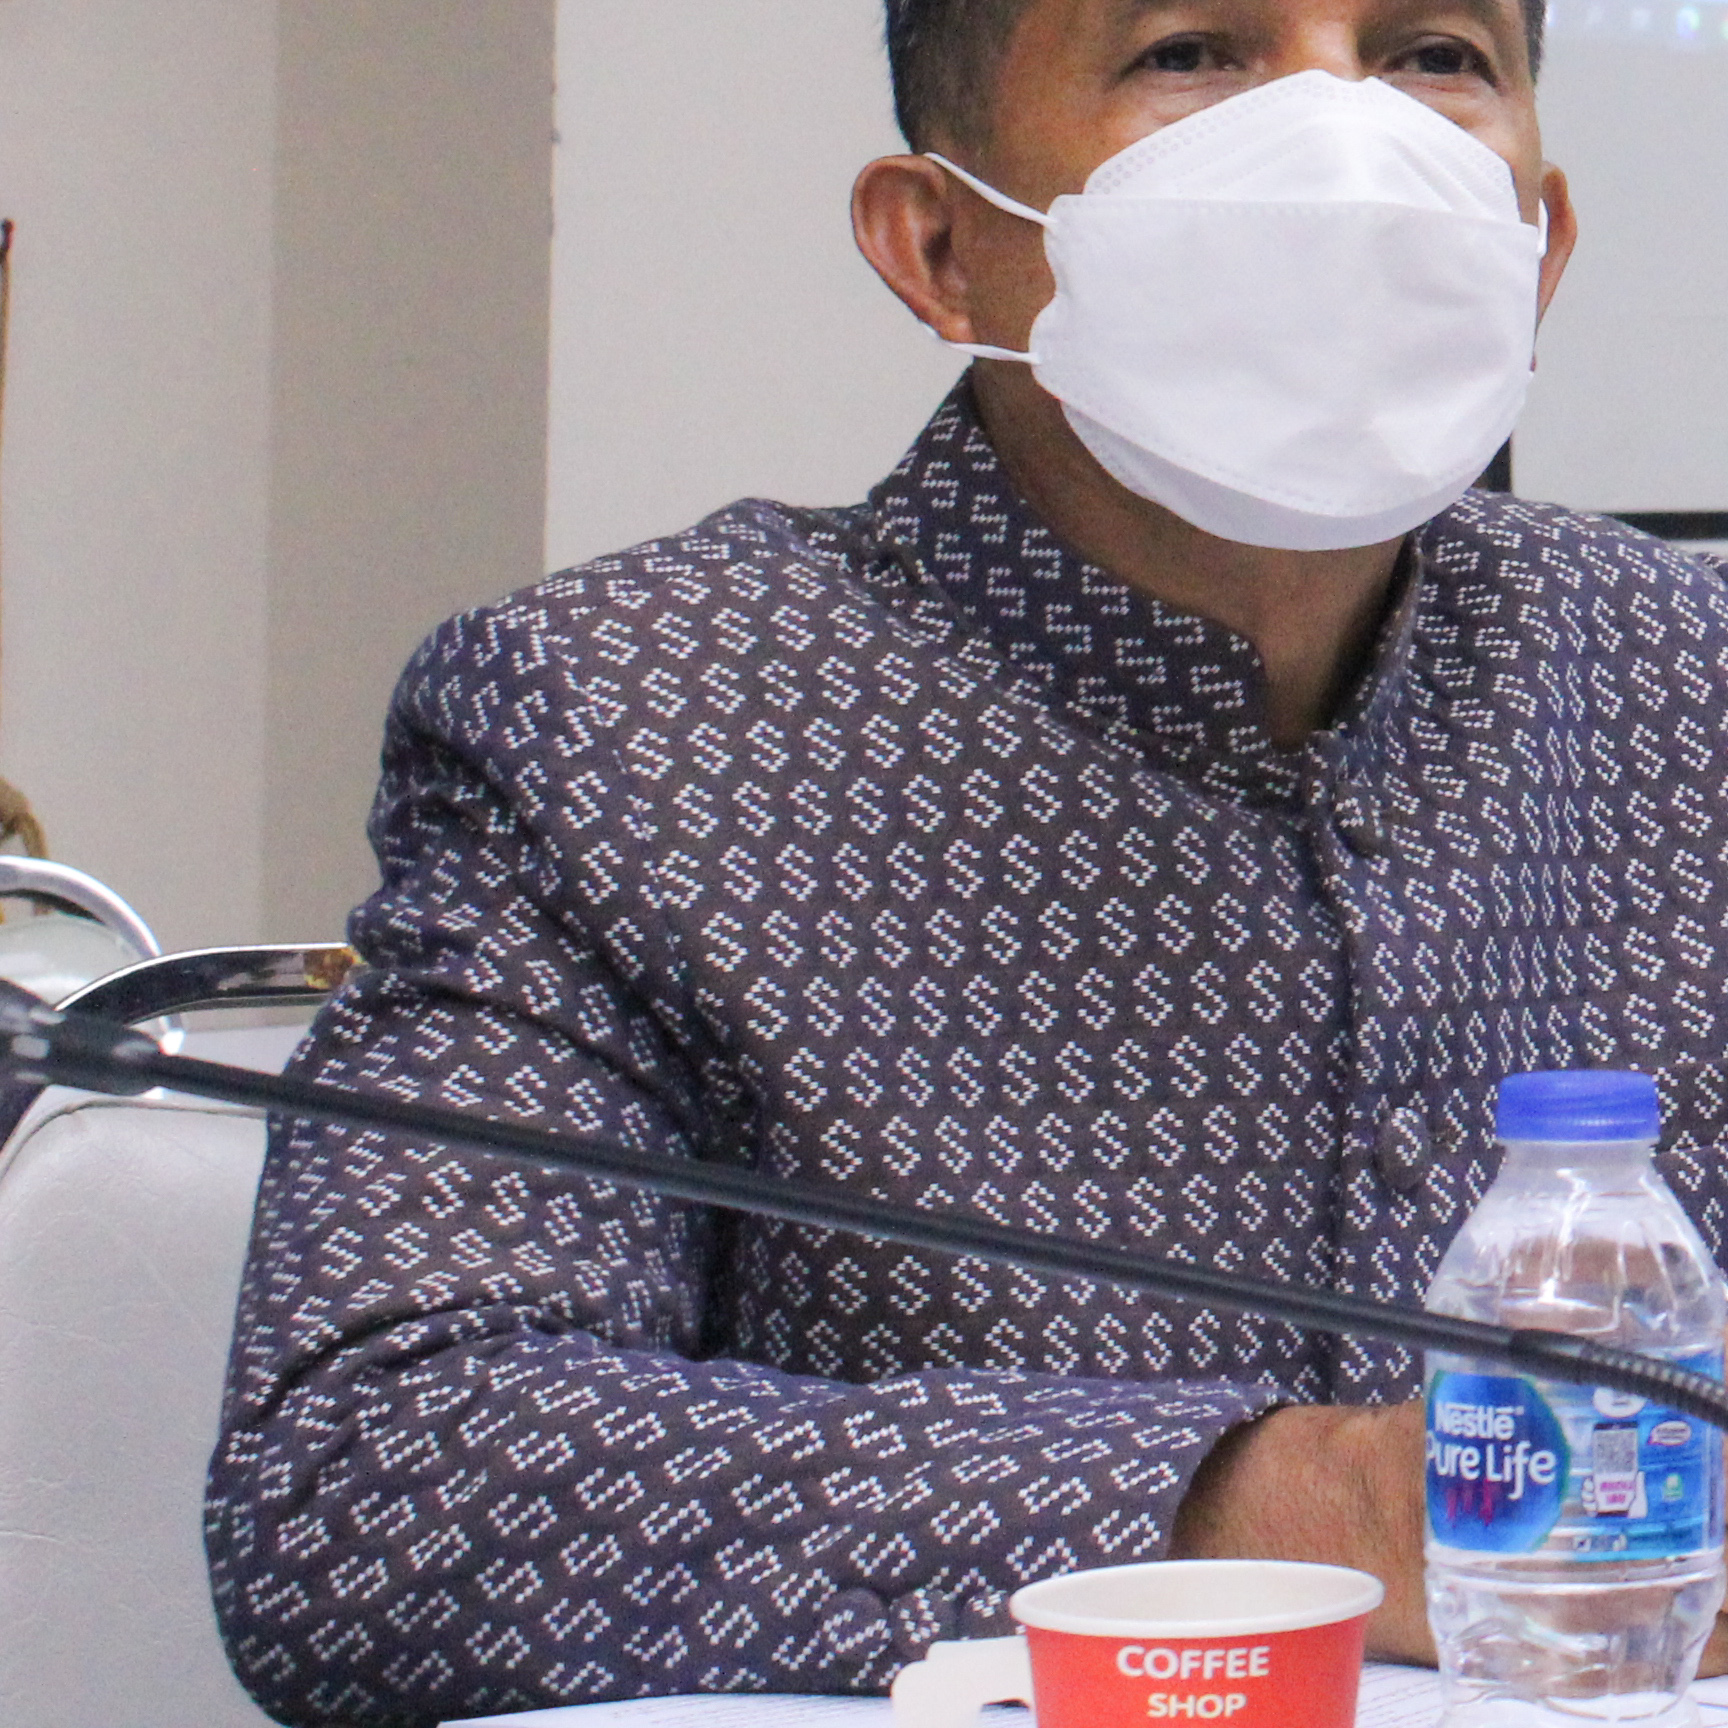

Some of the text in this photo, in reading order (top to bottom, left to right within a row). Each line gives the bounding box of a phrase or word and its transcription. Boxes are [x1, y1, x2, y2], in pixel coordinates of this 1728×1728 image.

[1485, 1440, 1558, 1501] Life
[1117, 1644, 1271, 1681] COFFEE
[1147, 1691, 1247, 1719] SHOP
